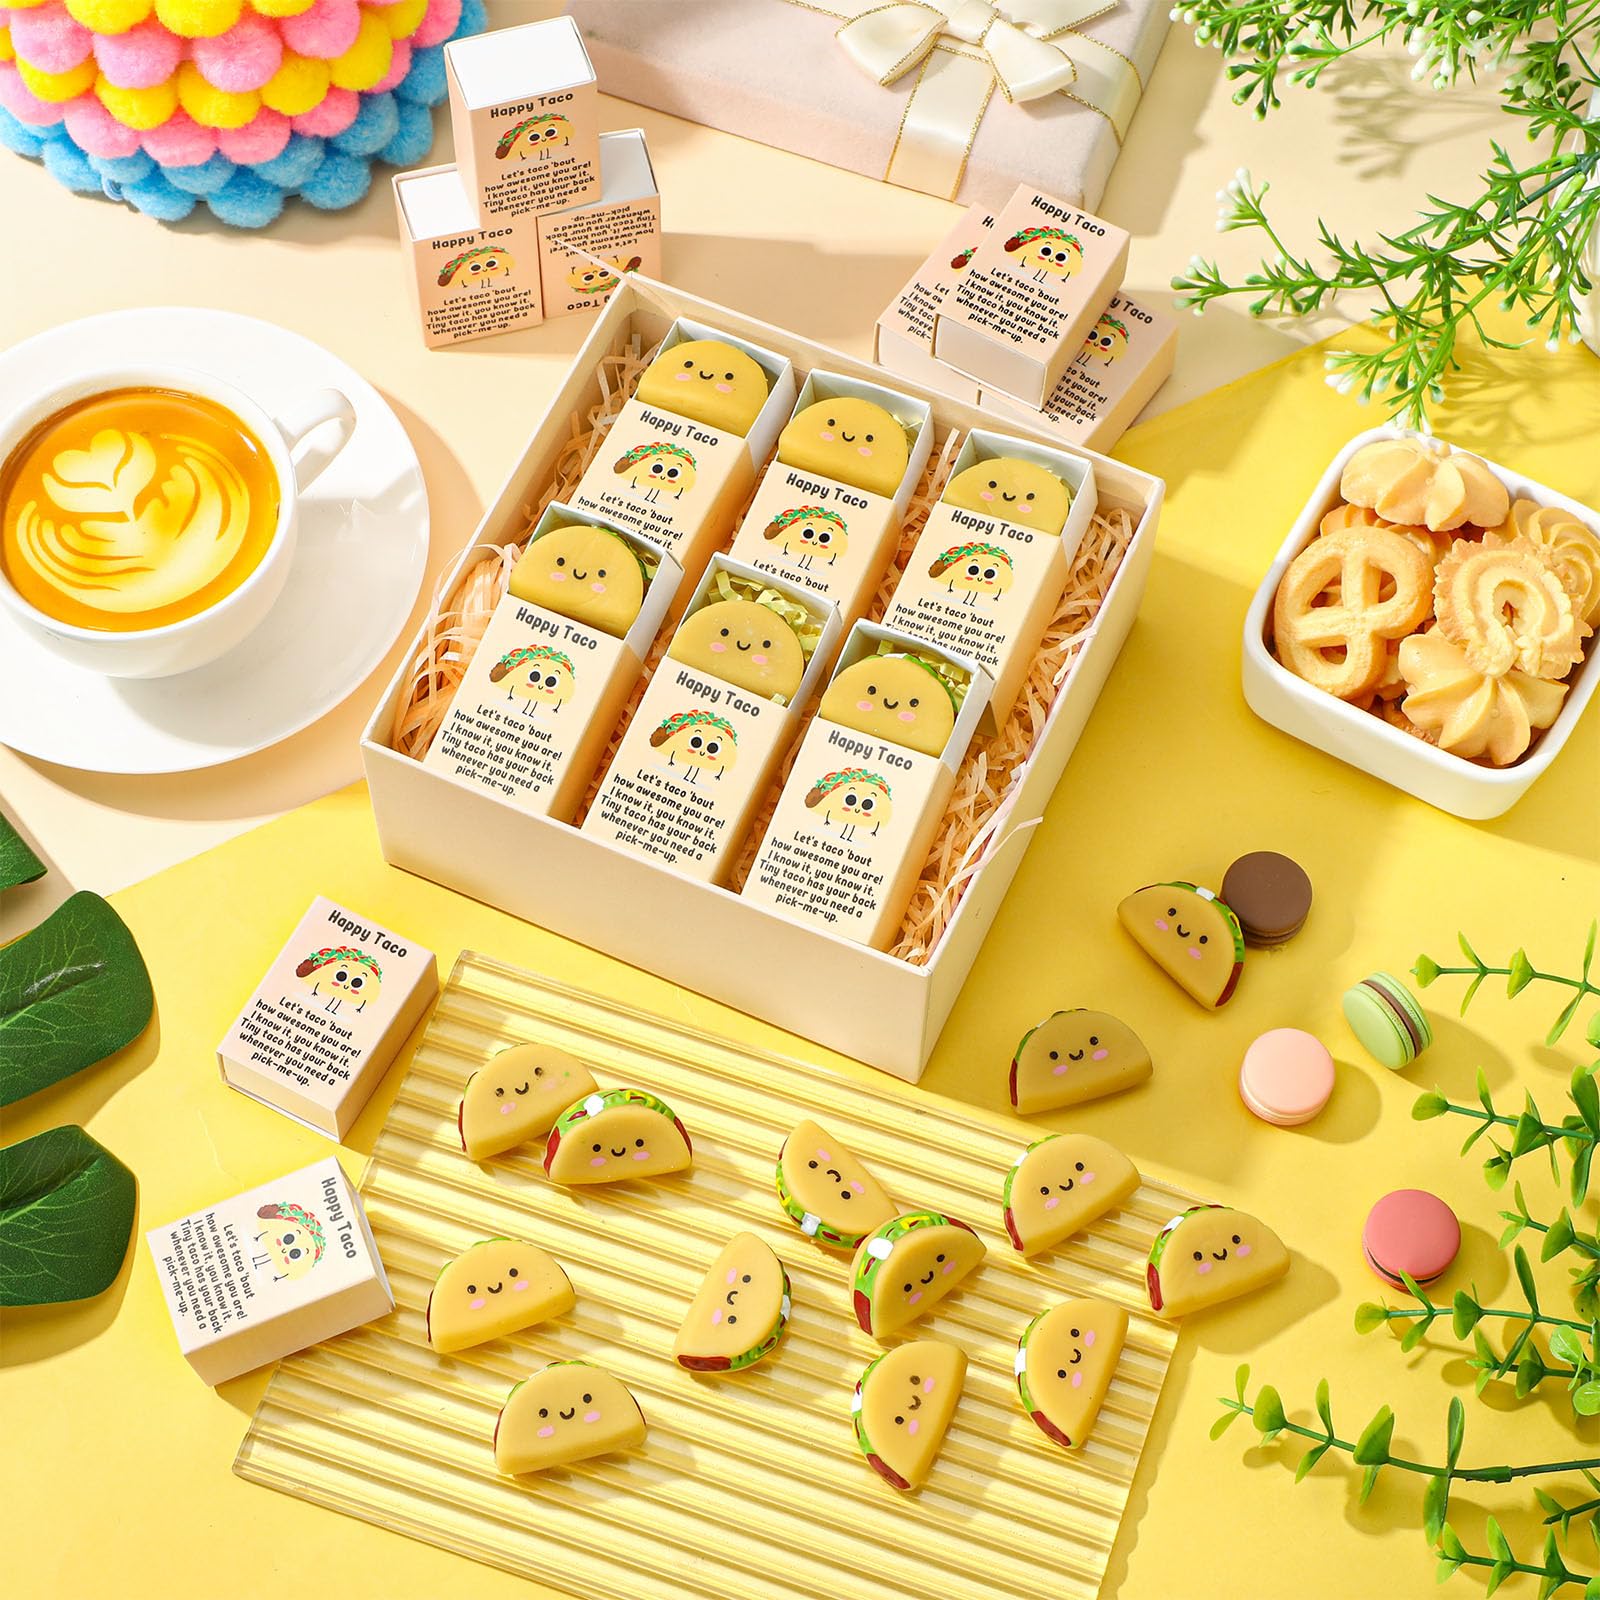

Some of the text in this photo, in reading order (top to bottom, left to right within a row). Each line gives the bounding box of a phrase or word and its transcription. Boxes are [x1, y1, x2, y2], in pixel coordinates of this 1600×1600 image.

[490, 93, 573, 119] Happy Taco
[484, 160, 591, 193] how awesome you are!
[501, 157, 575, 181] Let's taco 'bout
[510, 198, 570, 217] pick-me-up.
[1030, 195, 1105, 237] Happy Taco
[432, 228, 513, 250] Happy Taco
[427, 289, 531, 316] how awesome you are!
[443, 286, 516, 306] Let's taco 'bout
[899, 295, 918, 312] Tiny
[912, 294, 936, 311] know
[913, 282, 932, 297] how
[969, 268, 1069, 321] how awesome you are!
[990, 267, 1059, 305] Let's taco 'bout
[956, 283, 976, 300] Tiny
[977, 294, 997, 309] taco
[997, 304, 1014, 317] has
[1014, 313, 1037, 327] your
[1037, 323, 1060, 339] back
[956, 296, 999, 319] whenever
[998, 317, 1017, 329] you
[1016, 325, 1040, 340] need
[967, 313, 1023, 344] pick-me-up.
[1123, 299, 1153, 324] Taco
[453, 322, 511, 339] pick-me-up.
[1070, 381, 1107, 404] you are!
[1078, 371, 1100, 389] 'bout
[1053, 394, 1075, 408] your
[1075, 404, 1096, 421] back
[639, 410, 718, 446] Happy Taco
[600, 492, 624, 507] Let's
[625, 501, 647, 515] taco
[650, 508, 673, 525] 'bout
[785, 472, 868, 509] Happy Taco
[577, 496, 598, 509] how
[598, 505, 643, 526] awesome
[642, 521, 661, 533] you
[662, 528, 683, 541] are!
[950, 509, 1033, 543] Happy Taco
[752, 559, 829, 592] Let's taco 'bout
[515, 606, 597, 650] Happy Taco
[895, 603, 1006, 644] how awesome you are!
[917, 597, 994, 628] Let's taco 'bout
[675, 670, 760, 717] Happy Taco
[453, 708, 563, 761] how awesome you are!
[476, 704, 552, 743] Let's taco 'bout
[441, 730, 554, 785] Tiny taco has your back
[828, 729, 913, 770] Happy Taco
[455, 765, 516, 796] pick-me-up.
[636, 768, 714, 810] Let's taco 'bout
[613, 773, 725, 829] how awesome you are!
[601, 794, 717, 854] Tiny taco has your back
[615, 830, 677, 864] pick-me-up.
[770, 836, 884, 885] how awesome you are!
[793, 830, 872, 867] Let's taco 'bout
[759, 858, 876, 910] Tiny taco has your back
[775, 893, 838, 923] pick-me-up.
[327, 909, 407, 958] Happy Taco
[255, 998, 361, 1058] how awesome you are!
[278, 996, 352, 1040] Let's taco 'bout
[240, 1017, 350, 1080] Tiny taco has your back
[250, 1051, 310, 1087] pick-me-up.
[321, 1177, 357, 1258] Happy Taco
[180, 1218, 223, 1334] Tiny taco has your back
[205, 1212, 248, 1320] how awesome you are!
[223, 1223, 255, 1299] Let's taco 'bout
[162, 1255, 188, 1317] pick-me-up.
